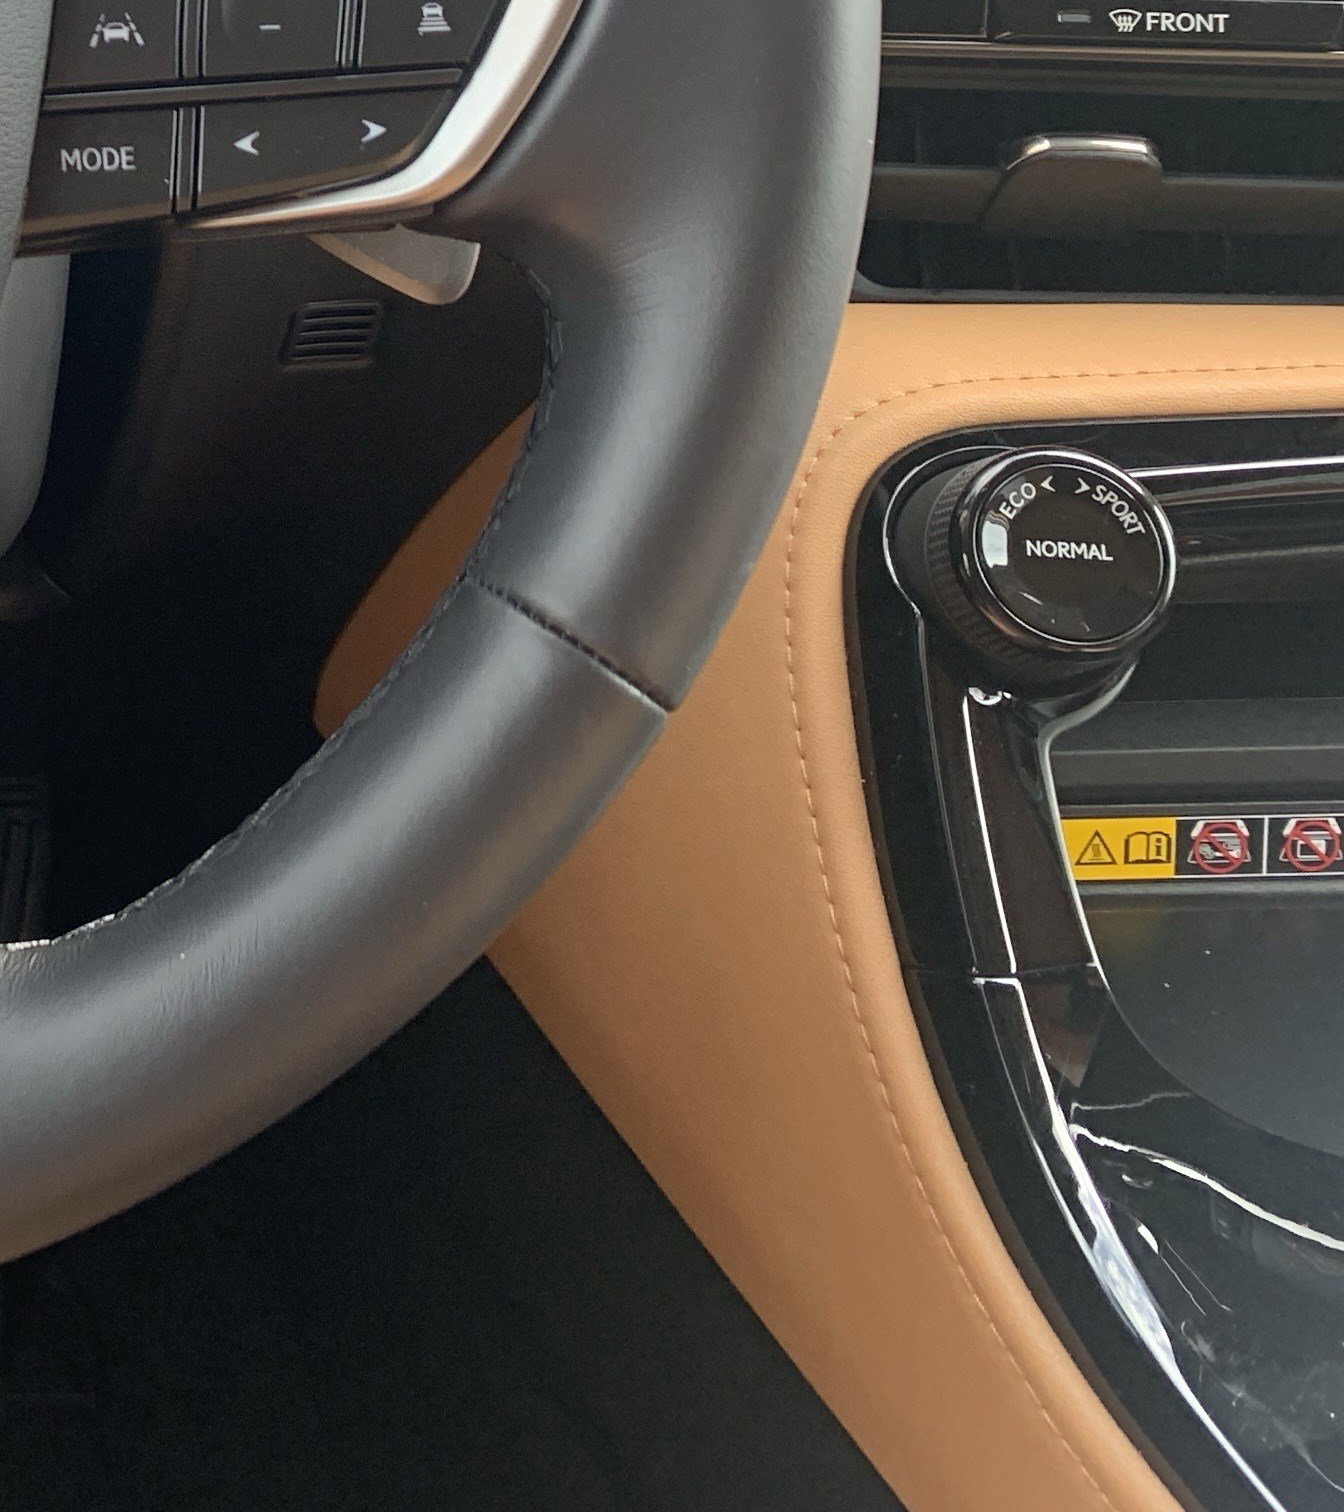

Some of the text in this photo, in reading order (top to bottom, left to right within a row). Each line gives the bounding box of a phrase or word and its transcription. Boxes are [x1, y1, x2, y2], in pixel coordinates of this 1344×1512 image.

[1145, 12, 1230, 34] FRONT
[59, 145, 137, 172] MODE
[999, 482, 1036, 520] ECO
[1091, 484, 1146, 535] SPORT
[1026, 539, 1114, 561] NORMAL
